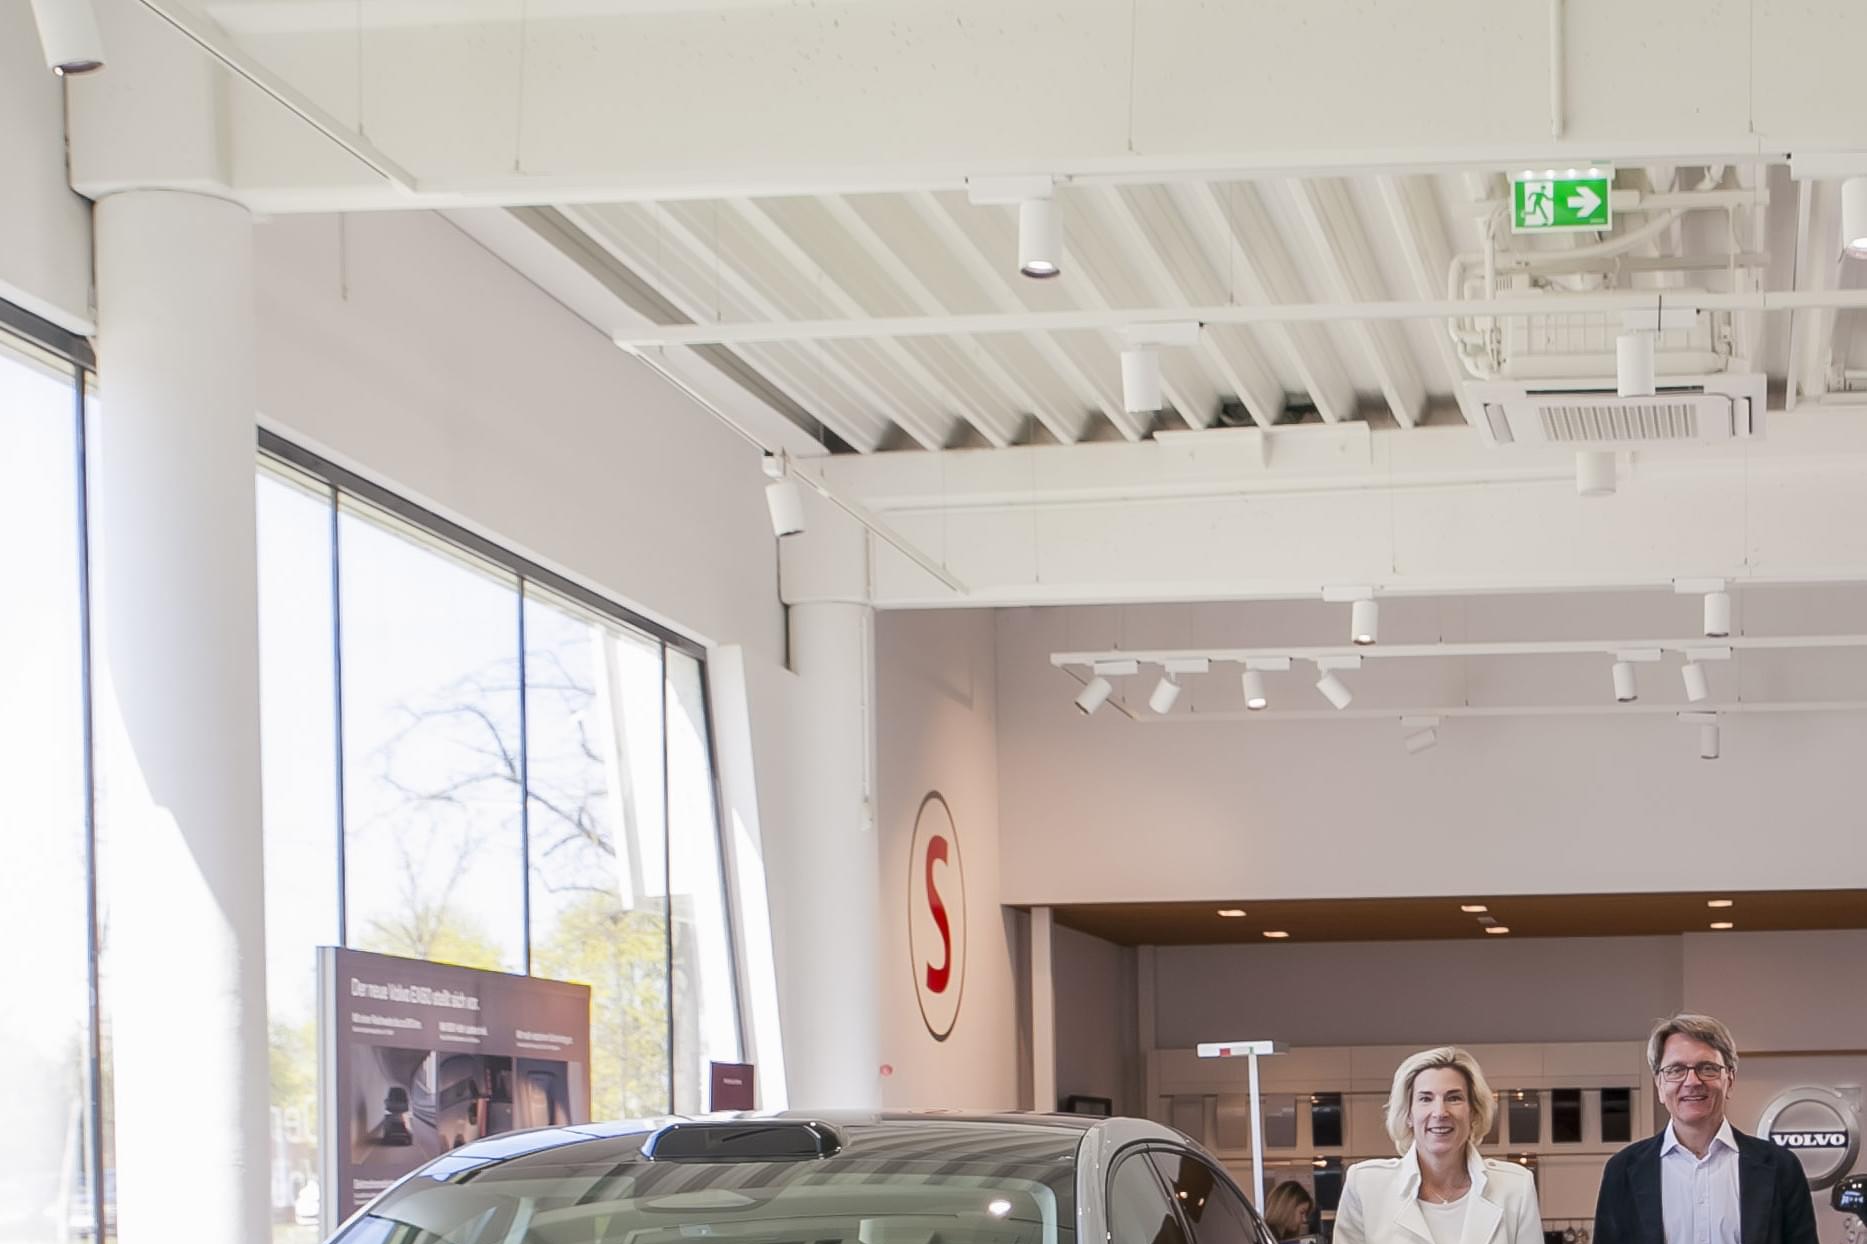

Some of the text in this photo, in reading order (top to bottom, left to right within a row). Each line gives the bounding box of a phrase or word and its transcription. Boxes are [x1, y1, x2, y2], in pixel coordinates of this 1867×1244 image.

[926, 835, 951, 993] S
[351, 978, 367, 997] Der
[368, 984, 387, 1000] neue
[1772, 1133, 1846, 1147] VOLVO
